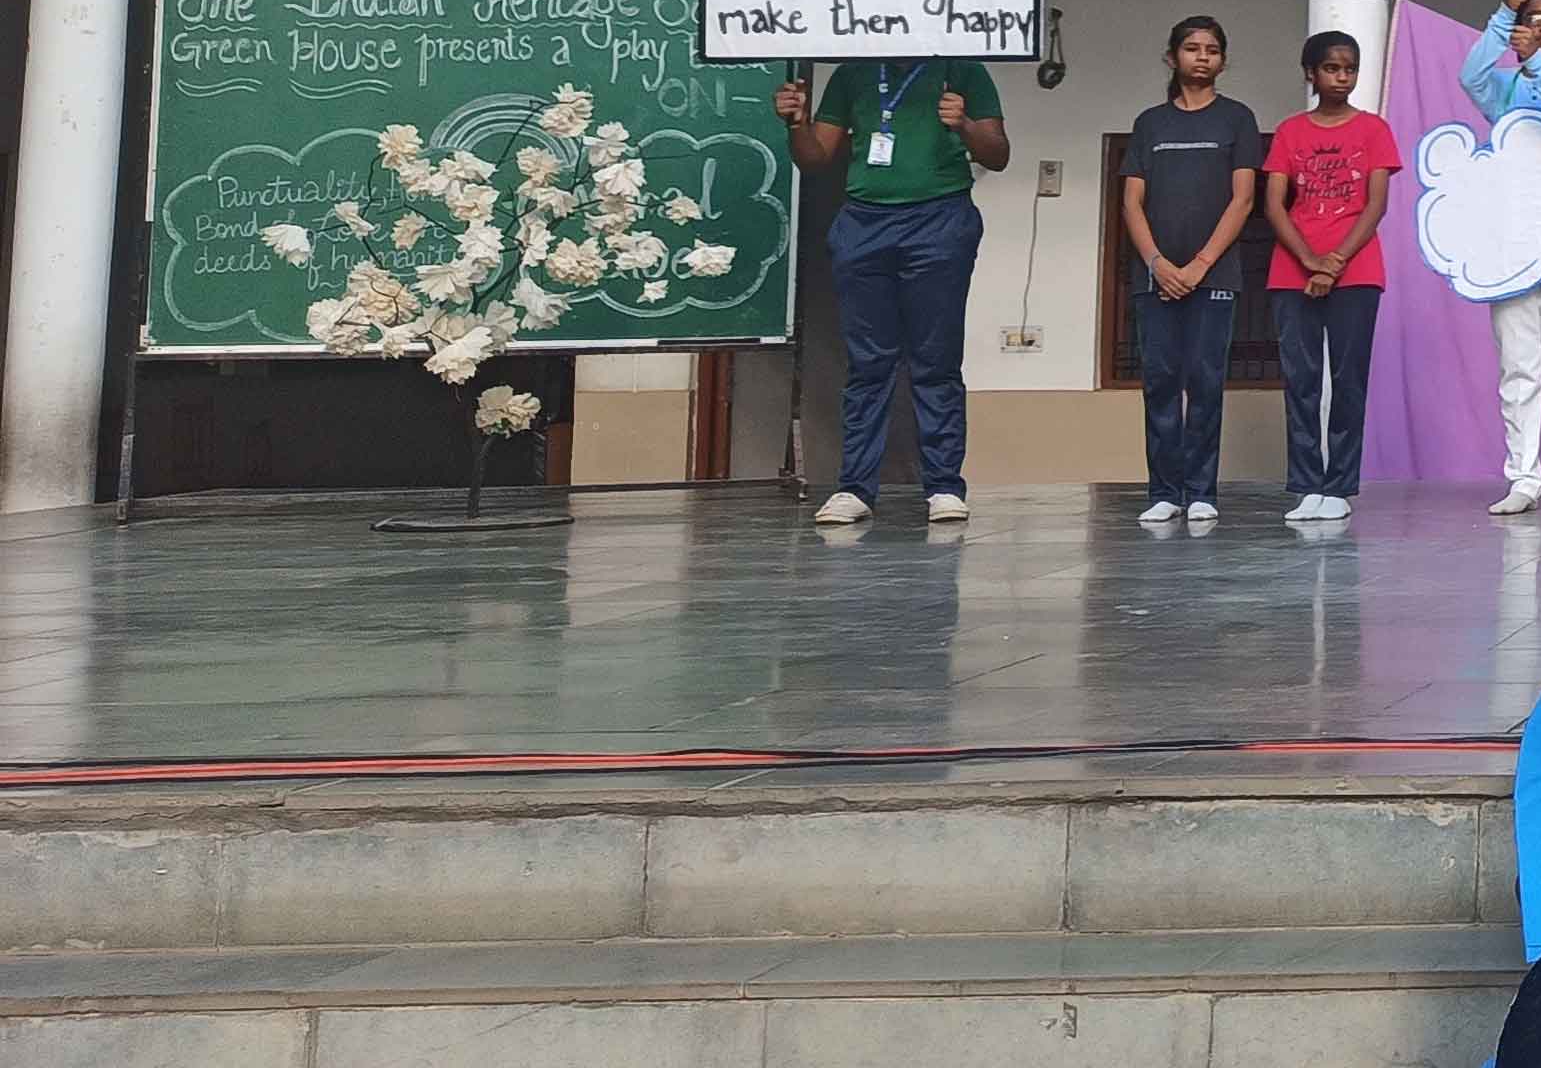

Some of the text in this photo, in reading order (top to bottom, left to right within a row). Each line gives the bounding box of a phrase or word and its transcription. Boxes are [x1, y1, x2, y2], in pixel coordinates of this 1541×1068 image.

[718, 0, 807, 34] make
[171, 33, 273, 69] Green
[287, 30, 401, 74] House
[415, 29, 534, 86] presents
[551, 36, 573, 65] a
[611, 30, 669, 91] play
[194, 244, 271, 274] deeds
